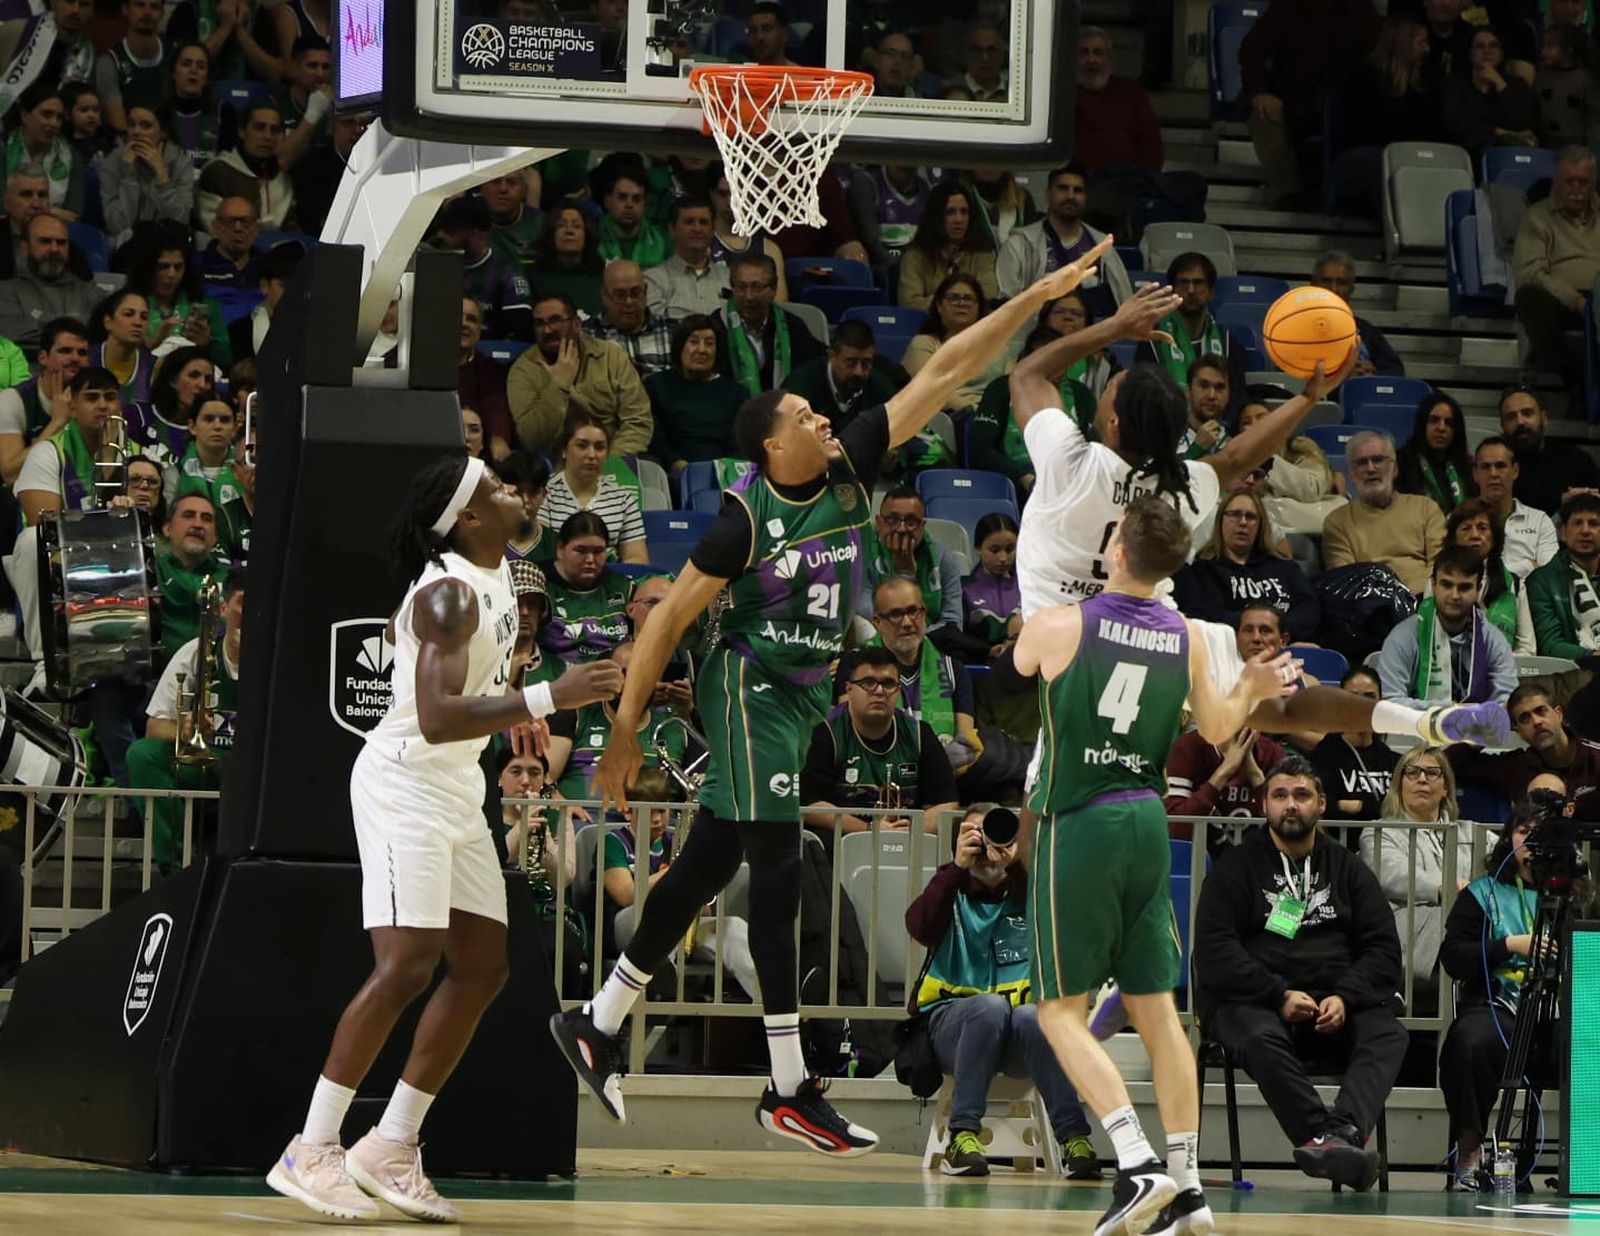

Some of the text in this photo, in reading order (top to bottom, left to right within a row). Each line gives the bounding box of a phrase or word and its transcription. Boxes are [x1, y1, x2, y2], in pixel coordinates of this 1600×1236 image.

[509, 25, 586, 40] BASKETBALL
[508, 36, 595, 52] CHAMPIONS
[508, 50, 555, 61] LEAGUE
[508, 62, 555, 72] SEASON X
[807, 583, 841, 620] 21
[1098, 618, 1181, 655] KALINOSKI
[346, 677, 393, 690] Fundac
[355, 692, 394, 705] Unica
[1097, 661, 1149, 735] 4
[346, 705, 388, 717] Balonc
